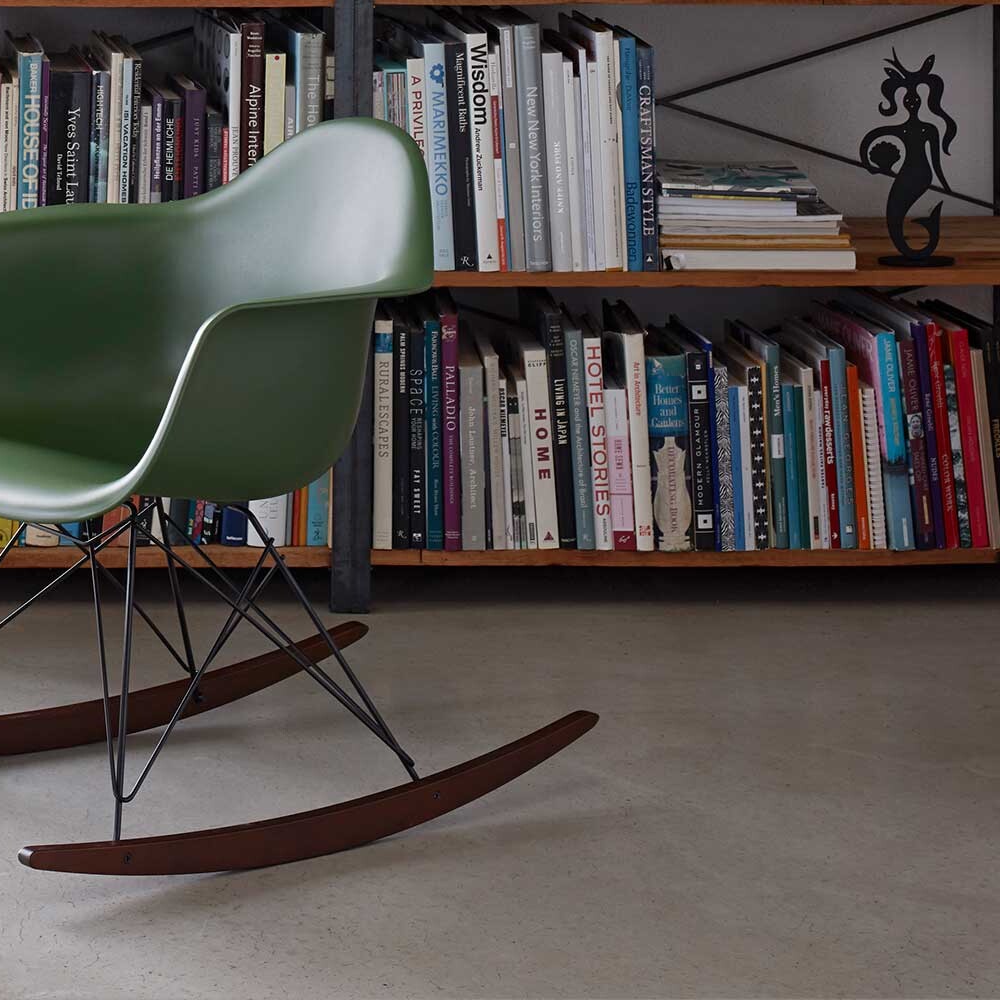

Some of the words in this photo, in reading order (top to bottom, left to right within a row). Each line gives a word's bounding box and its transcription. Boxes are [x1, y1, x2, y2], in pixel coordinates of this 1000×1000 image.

[30, 63, 38, 92] BAKER
[307, 75, 320, 99] The
[411, 76, 421, 85] A
[454, 52, 467, 105] Magnificent
[470, 44, 487, 125] Wisdom
[246, 85, 261, 127] Alpine
[457, 108, 467, 132] Baths
[525, 87, 537, 116] New
[24, 95, 40, 160] HOUSE
[67, 108, 80, 138] Yves
[166, 118, 174, 164] HEIMLICHE
[432, 91, 448, 195] MARIMEKKO
[474, 128, 482, 153] Andrew
[527, 120, 539, 150] New
[639, 85, 653, 182] CRAFTSMAN
[23, 164, 38, 190] OF
[66, 142, 79, 177] Saint
[165, 167, 173, 180] DIE
[476, 155, 484, 190] Zuckerman
[529, 152, 541, 181] York
[531, 185, 544, 242] Interiors
[626, 182, 639, 262] Badewonnen
[642, 187, 654, 236] STYLE
[883, 339, 893, 361] JAMIE
[379, 361, 389, 401] RURAL
[587, 346, 604, 417] HOTEL
[886, 364, 895, 392] OLIVER
[445, 366, 456, 431] PALLADIO
[467, 406, 476, 427] John
[379, 403, 389, 458] ESCAPES
[535, 409, 551, 480] HOME
[694, 409, 702, 456] GLAMOUR
[469, 469, 477, 509] Architect
[592, 425, 610, 516] STORIES
